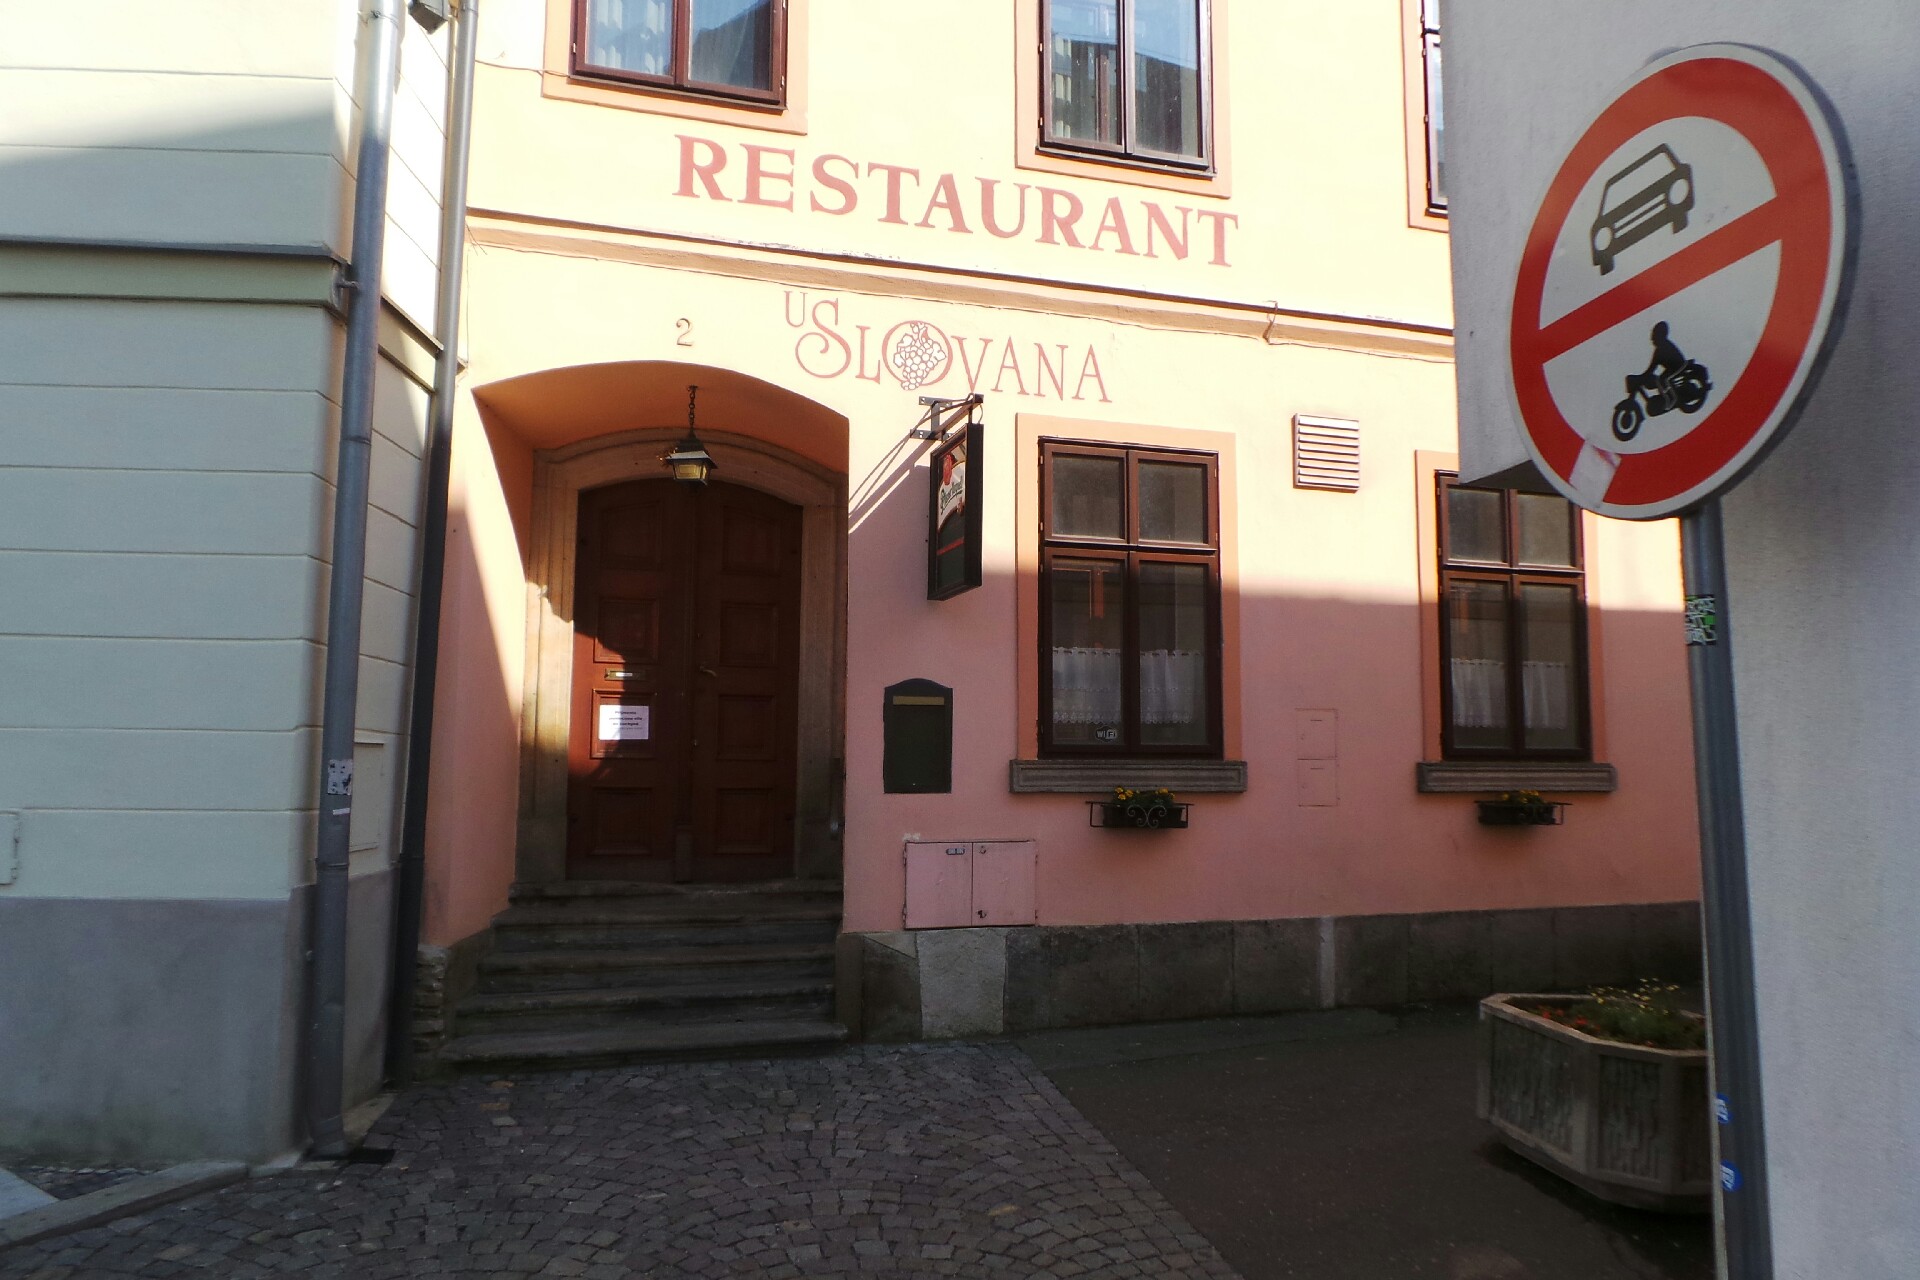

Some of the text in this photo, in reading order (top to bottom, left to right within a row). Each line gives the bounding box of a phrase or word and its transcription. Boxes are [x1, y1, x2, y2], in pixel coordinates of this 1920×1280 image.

[672, 134, 1239, 267] RESTAURANT
[676, 317, 693, 347] 2
[784, 290, 1113, 403] U SLOVANA
